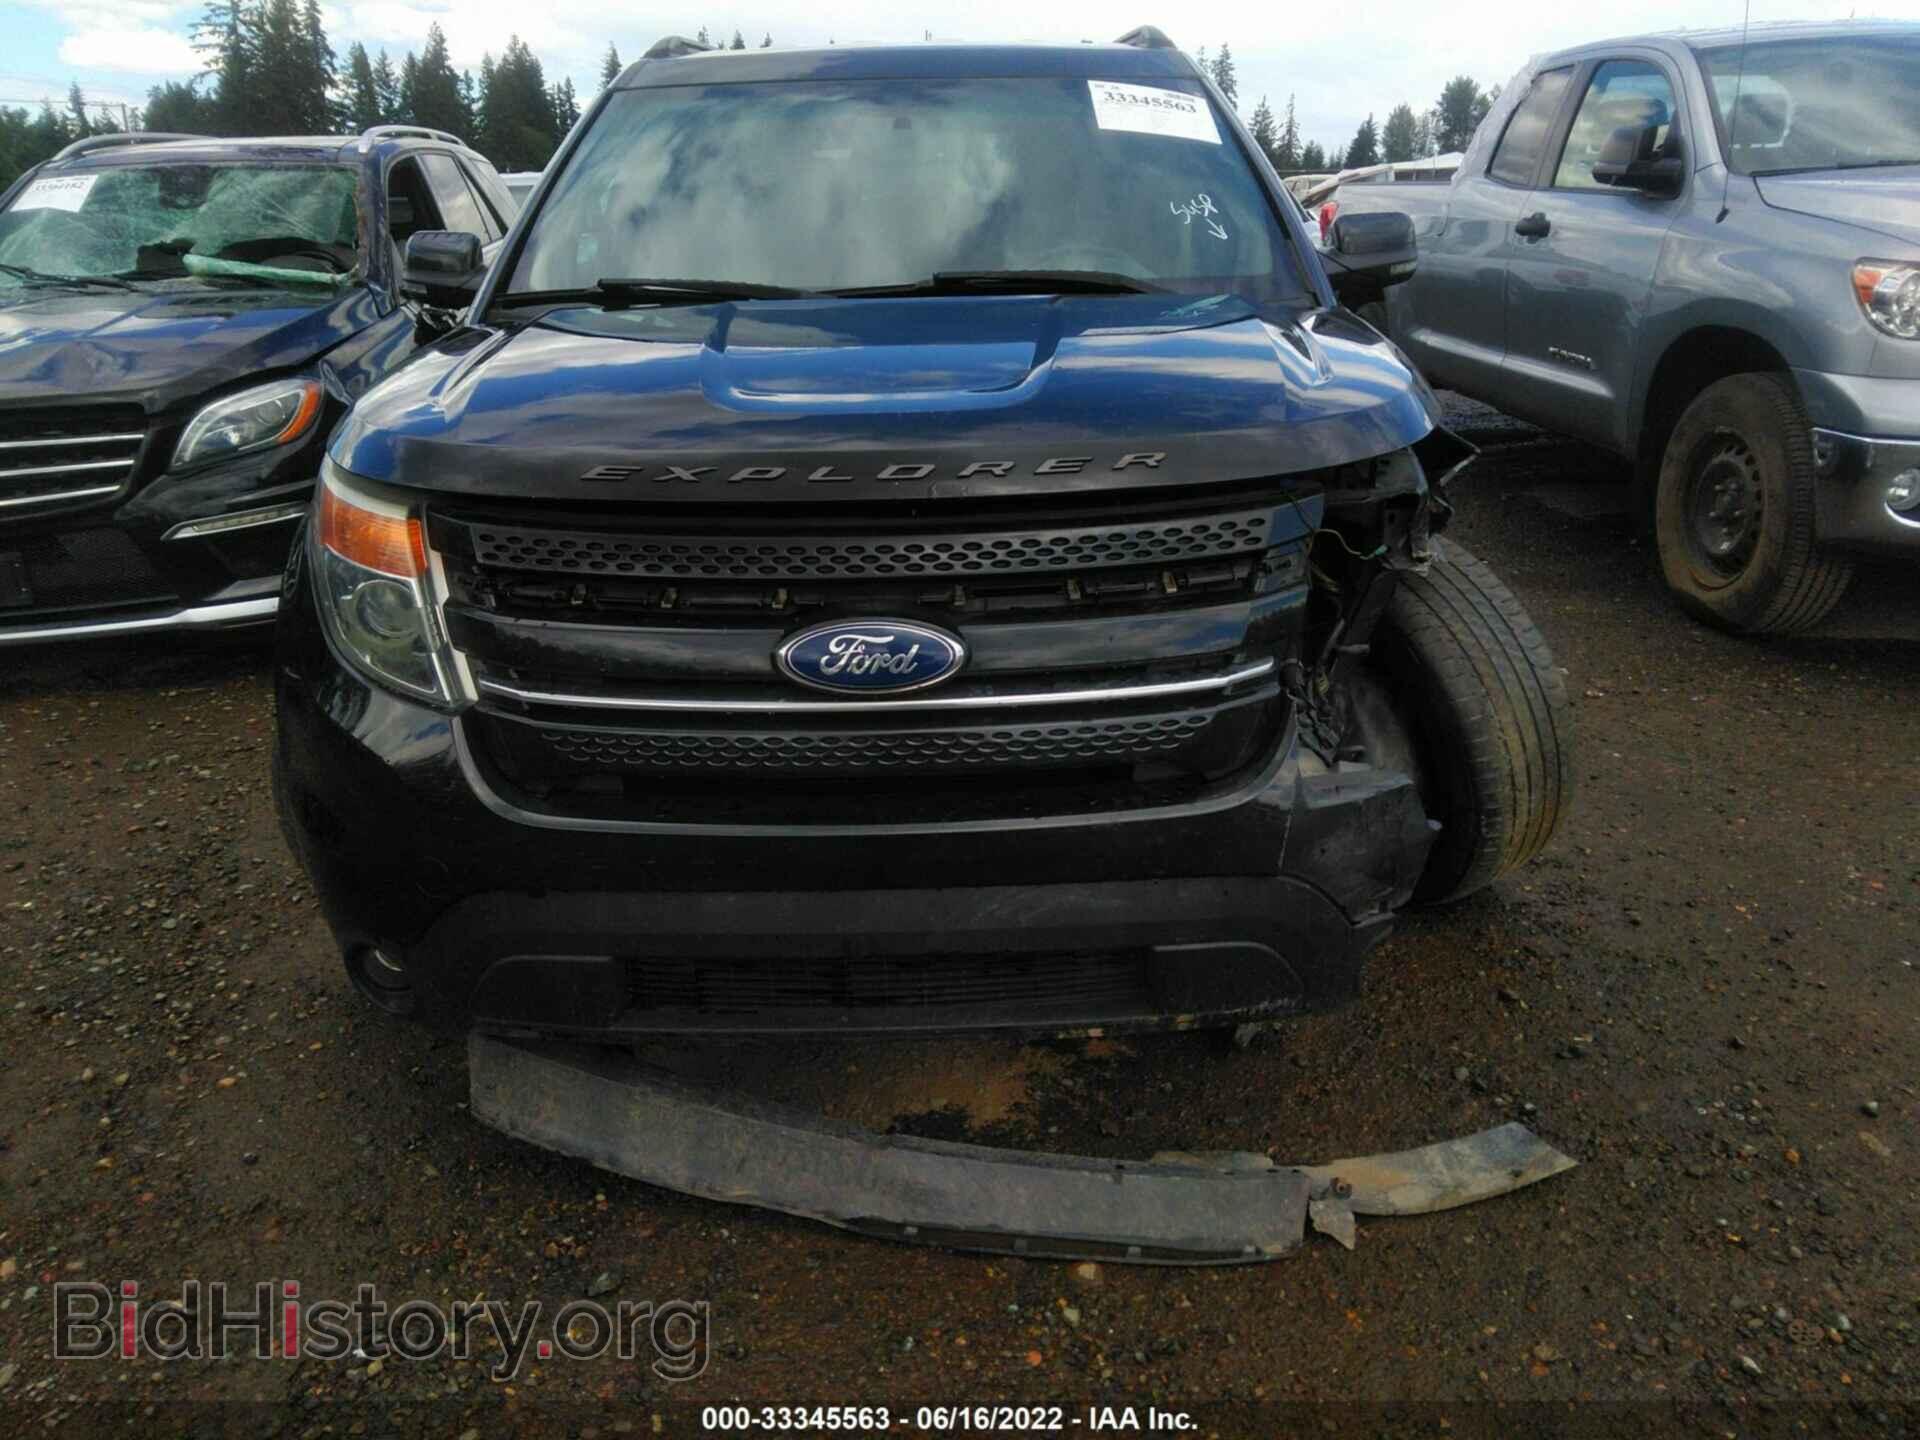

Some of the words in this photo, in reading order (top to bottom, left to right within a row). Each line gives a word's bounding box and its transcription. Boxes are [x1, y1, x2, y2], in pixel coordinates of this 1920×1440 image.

[1103, 91, 1197, 113] 33345563
[580, 452, 1167, 482] EXPLORER
[819, 634, 921, 675] Ford
